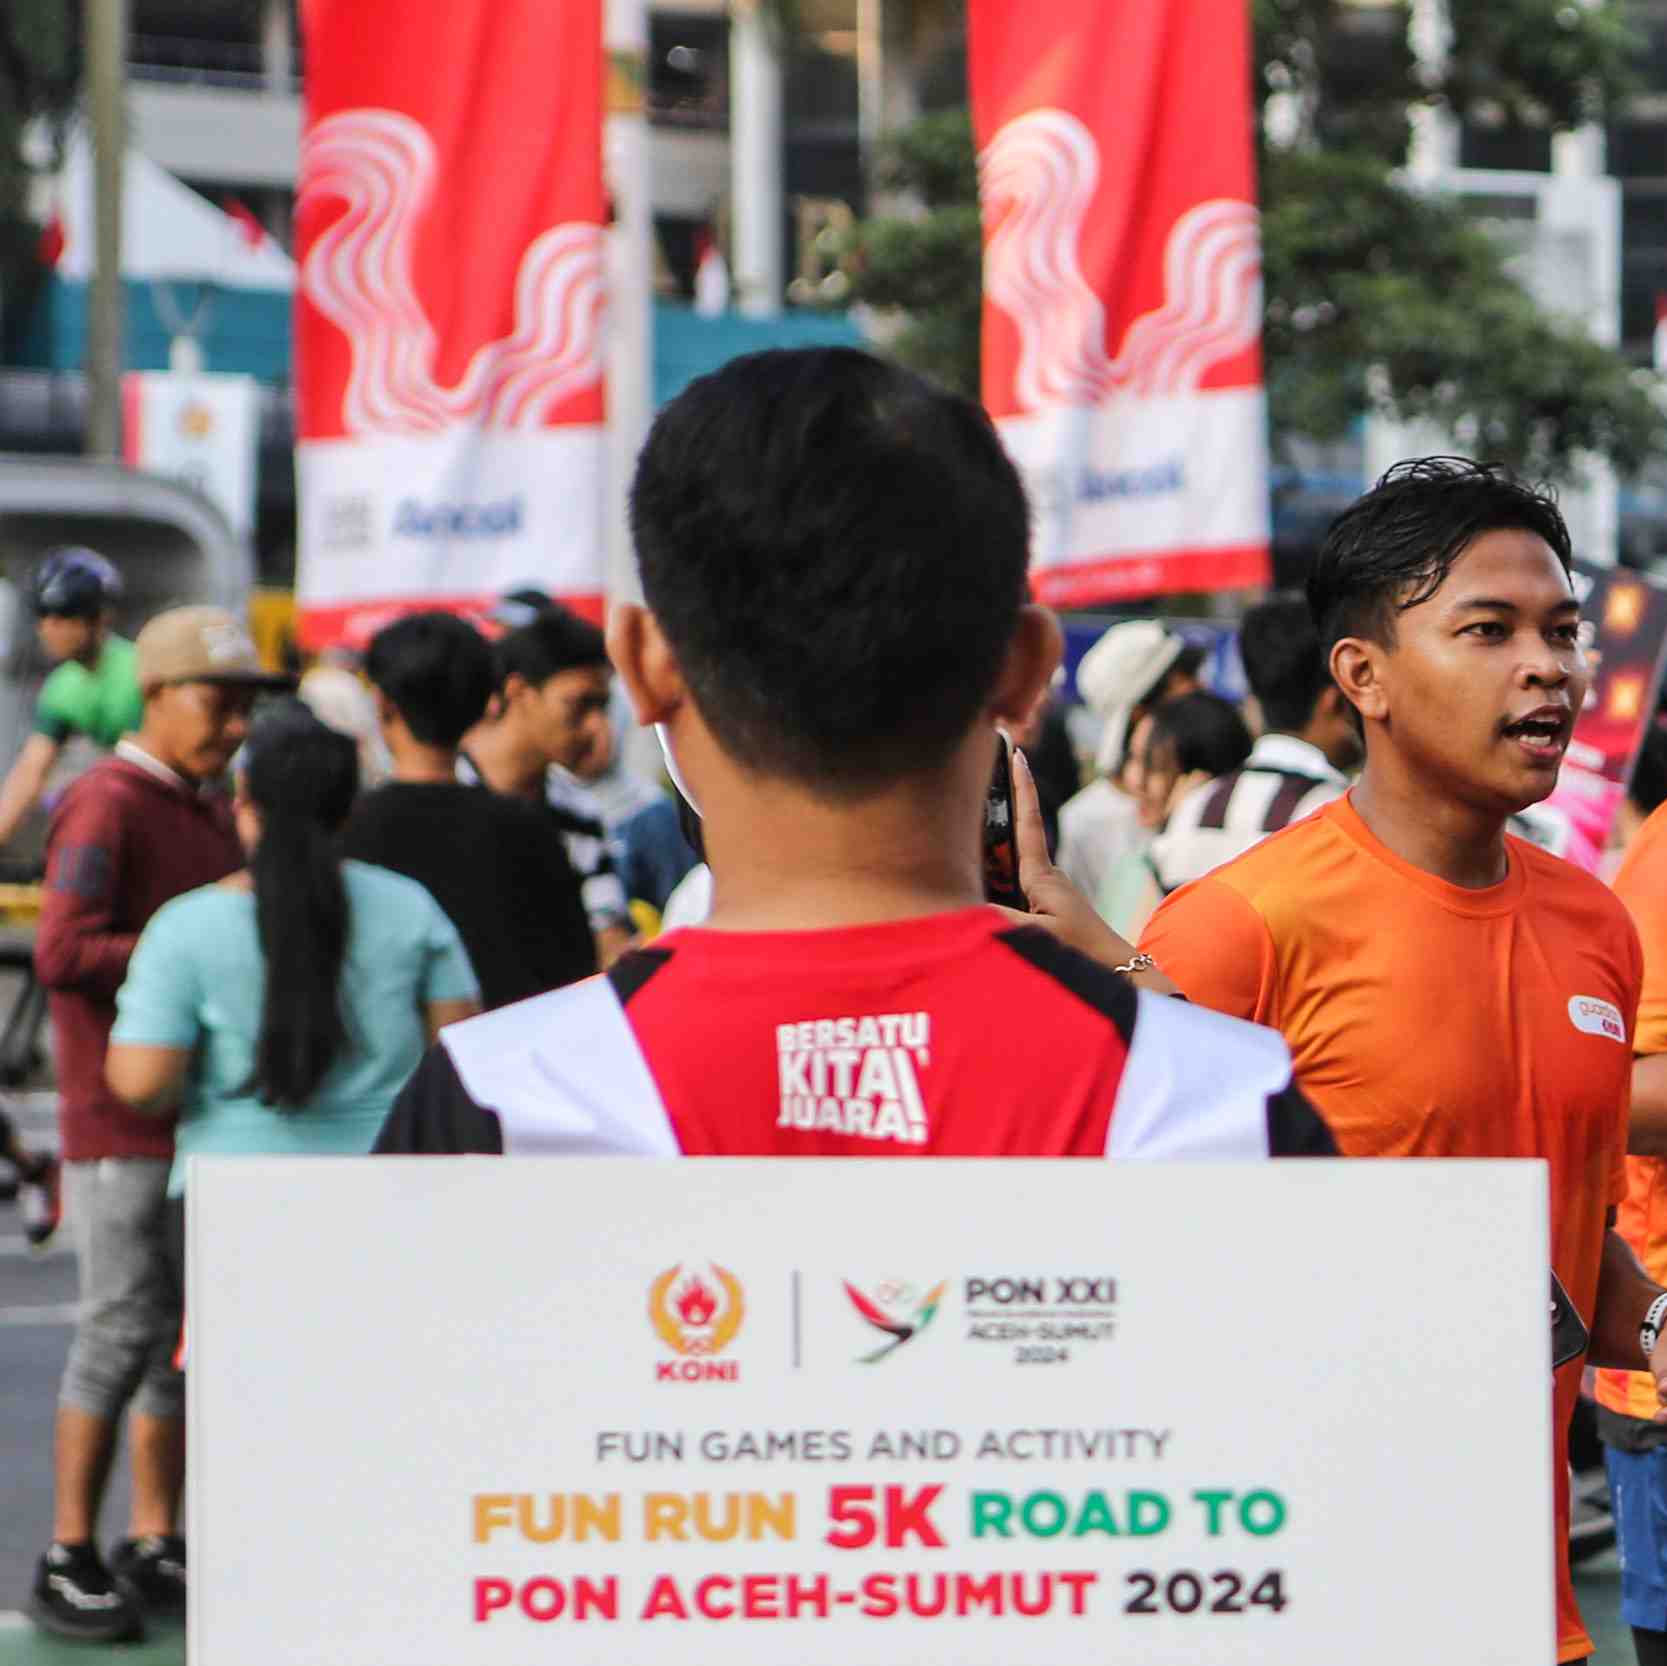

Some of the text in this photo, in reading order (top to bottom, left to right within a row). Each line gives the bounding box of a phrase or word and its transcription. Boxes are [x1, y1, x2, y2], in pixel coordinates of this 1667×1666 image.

[776, 1012, 930, 1050] BERSATU
[966, 1279, 1117, 1304] PON XXI
[656, 1361, 738, 1382] KONI
[597, 1430, 1171, 1462] FUN GAMES AND ACTIVITY
[474, 1485, 1287, 1548] FUN RUN 5K ROAD TO
[474, 1570, 1289, 1622] PON ACEH-SUMUT 2024
